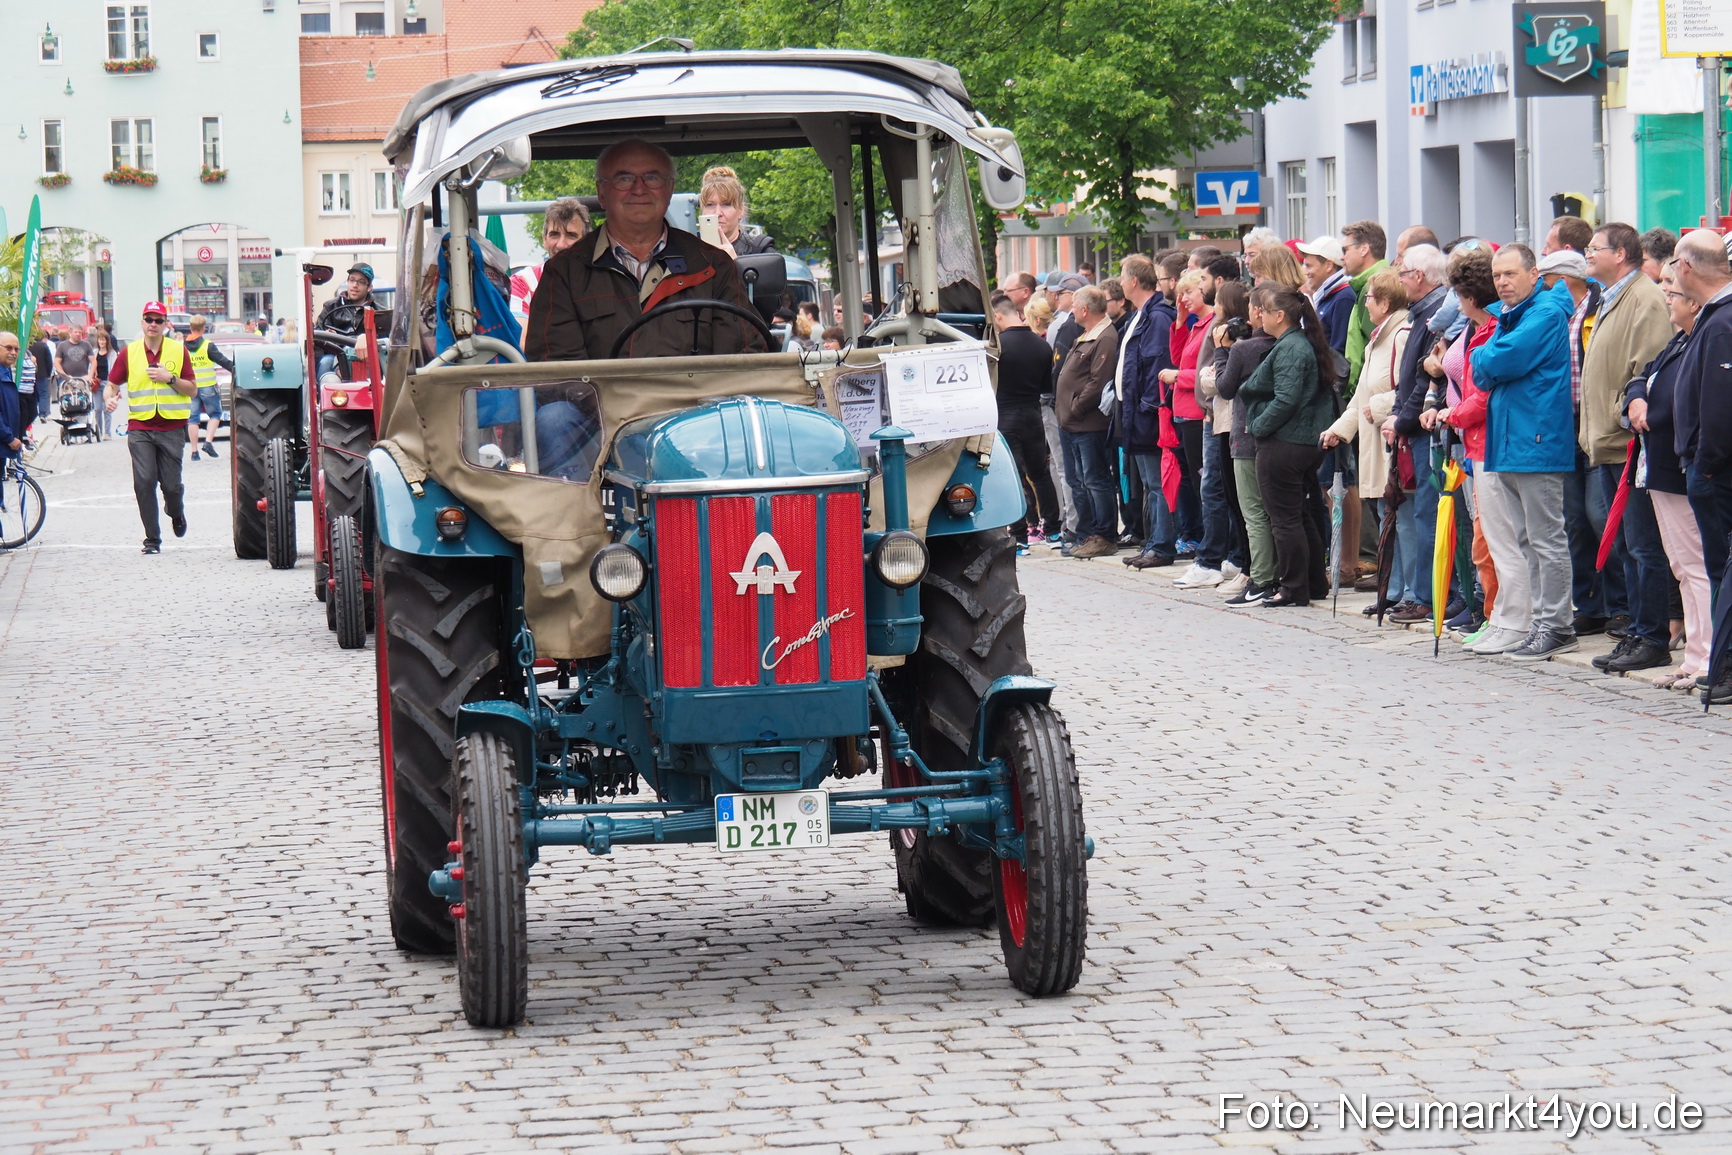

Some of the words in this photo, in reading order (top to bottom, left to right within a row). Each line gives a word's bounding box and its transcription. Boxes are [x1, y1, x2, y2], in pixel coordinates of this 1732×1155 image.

[1547, 28, 1578, 66] G2
[1427, 51, 1495, 102] Raiffeisenbank
[26, 228, 40, 302] DEKRA
[936, 364, 968, 384] 223
[762, 608, 855, 670] Combitrac
[742, 797, 775, 821] NM
[726, 826, 741, 848] D
[751, 822, 797, 847] 217
[807, 819, 822, 829] 05
[809, 834, 822, 844] 10
